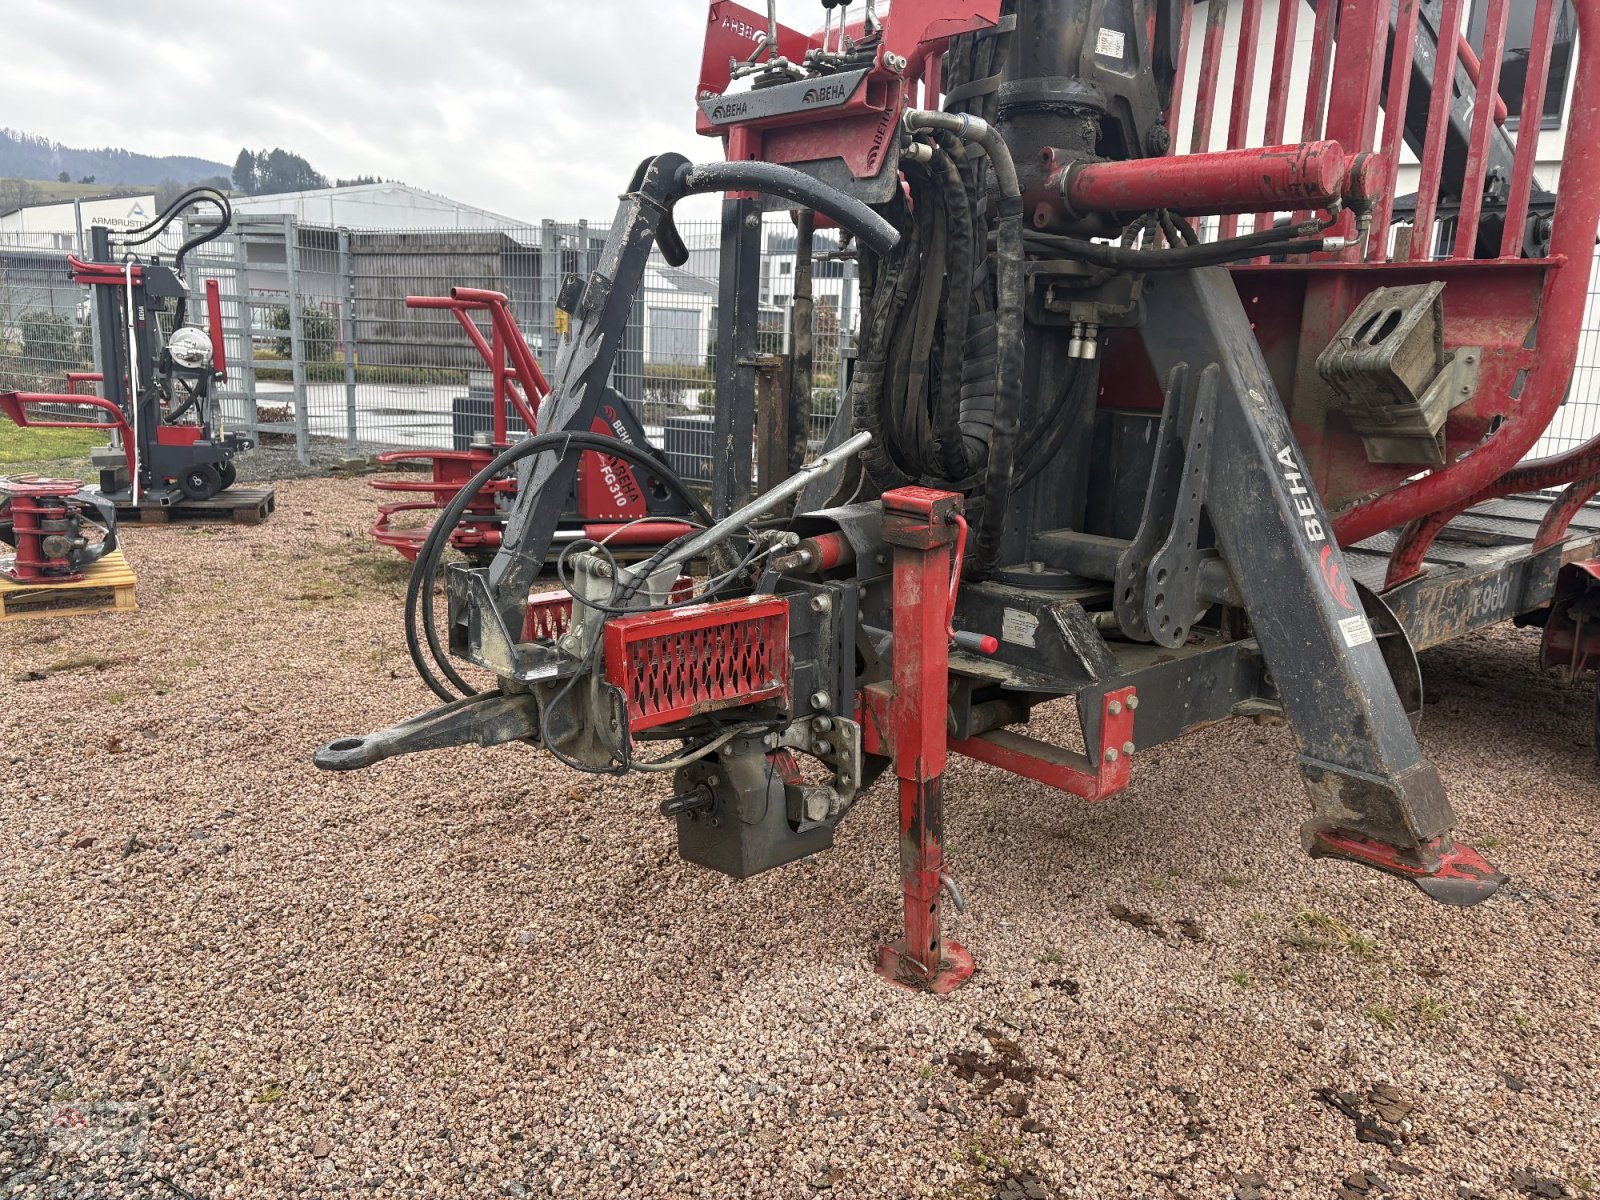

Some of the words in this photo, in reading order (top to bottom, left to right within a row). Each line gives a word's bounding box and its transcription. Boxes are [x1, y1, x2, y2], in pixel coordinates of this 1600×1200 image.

[725, 101, 747, 118] BEHA
[819, 84, 846, 101] BEHA
[873, 108, 894, 148] BEHA
[612, 419, 634, 445] BEHA
[600, 465, 628, 507] FG310
[614, 464, 640, 503] BEHA
[1276, 445, 1327, 542] BEHA
